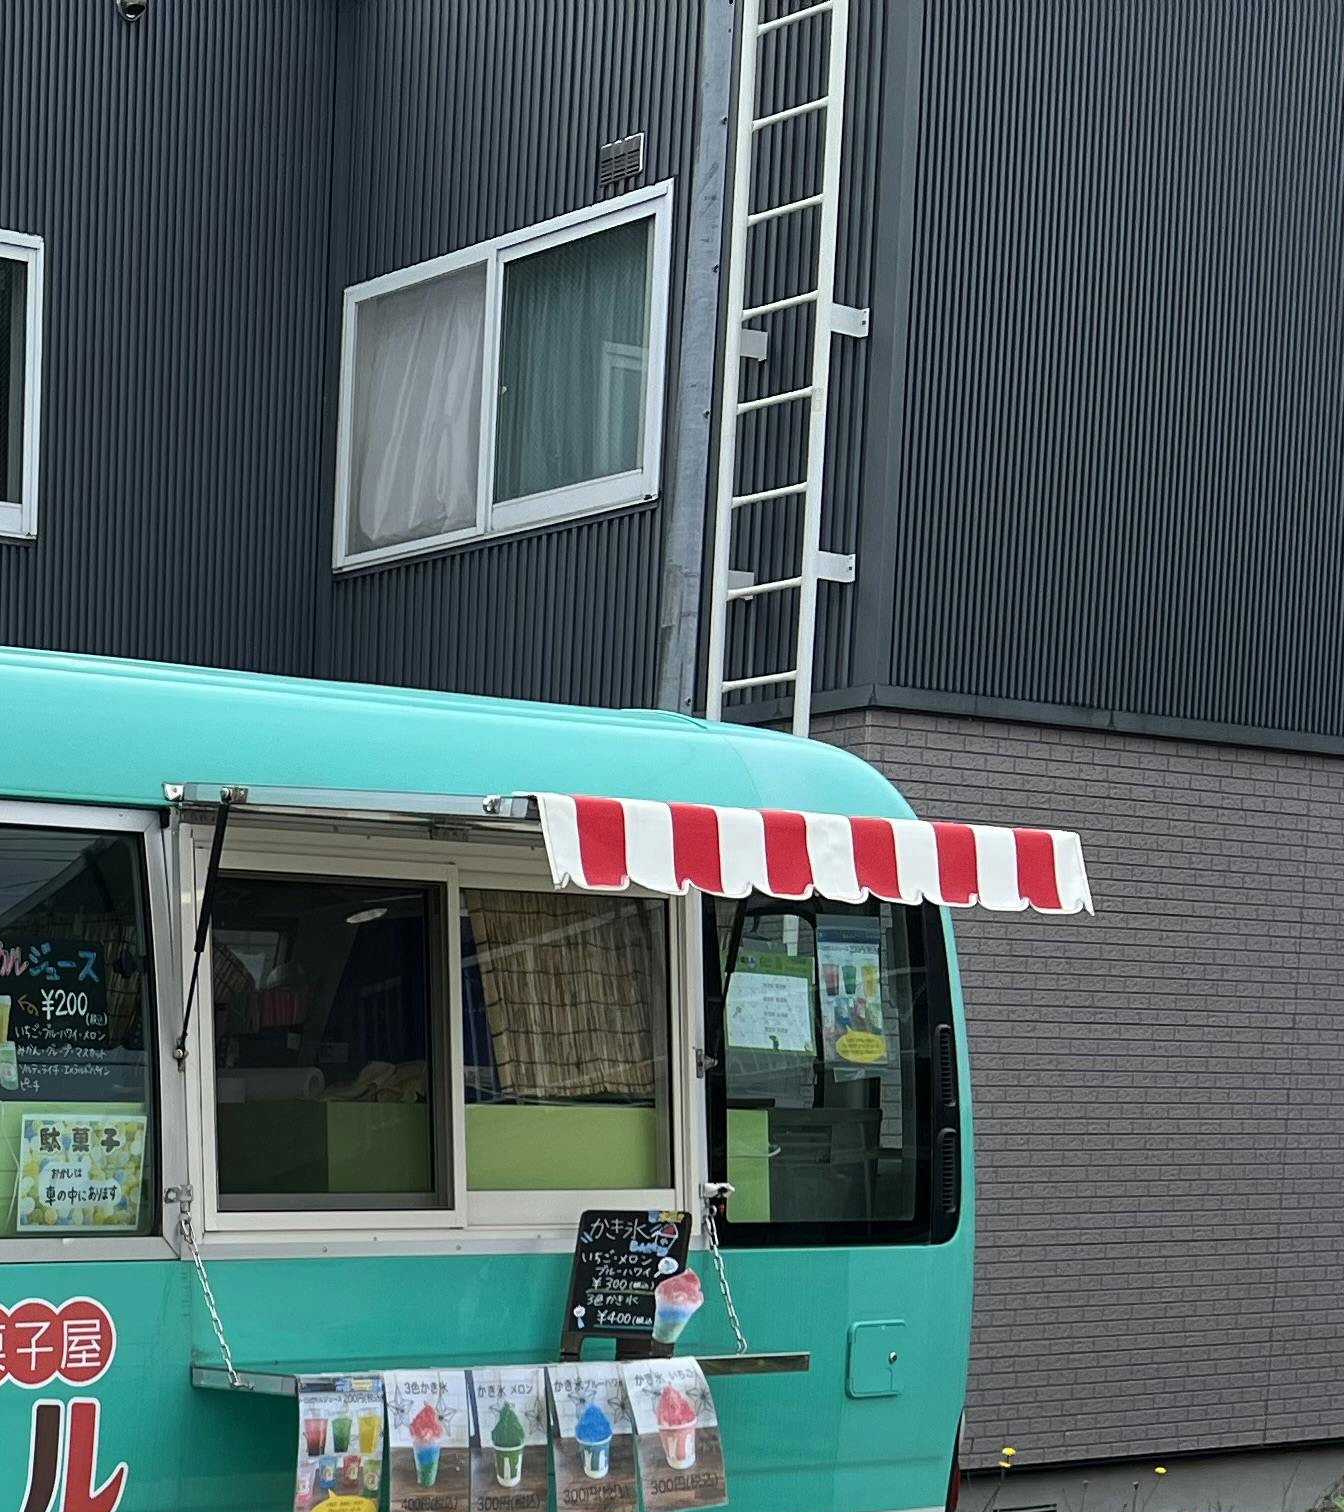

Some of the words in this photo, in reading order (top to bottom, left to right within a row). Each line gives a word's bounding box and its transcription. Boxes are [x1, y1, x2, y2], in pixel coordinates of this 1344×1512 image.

[41, 988, 88, 1021] ¥200
[39, 1127, 121, 1154] 駄菓子
[44, 1186, 118, 1205] 車の中にあります
[590, 1218, 651, 1241] かき氷
[596, 1265, 652, 1278] ブルーハワイ
[635, 1370, 665, 1385] かき氷
[478, 1384, 506, 1399] かき氷
[510, 1384, 533, 1395] メロン
